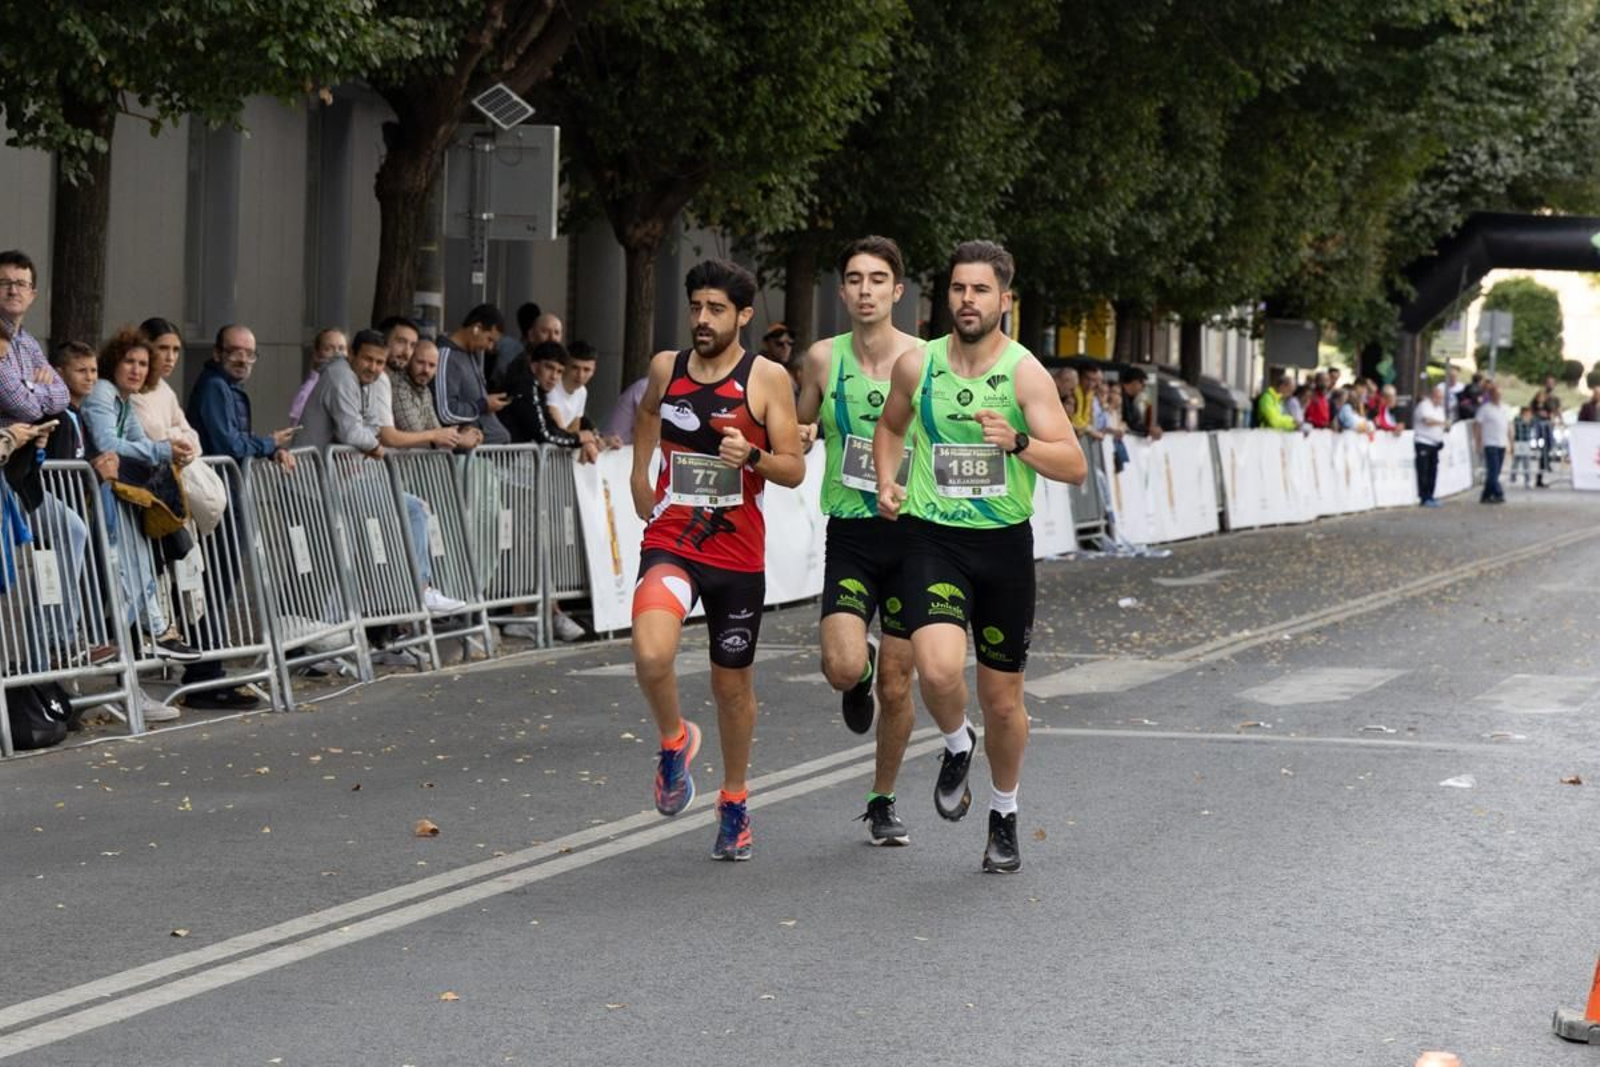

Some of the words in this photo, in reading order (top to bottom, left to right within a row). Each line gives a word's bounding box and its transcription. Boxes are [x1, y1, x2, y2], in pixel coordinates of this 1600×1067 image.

[939, 447, 950, 456] 36
[948, 459, 989, 476] 188
[692, 468, 718, 485] 77
